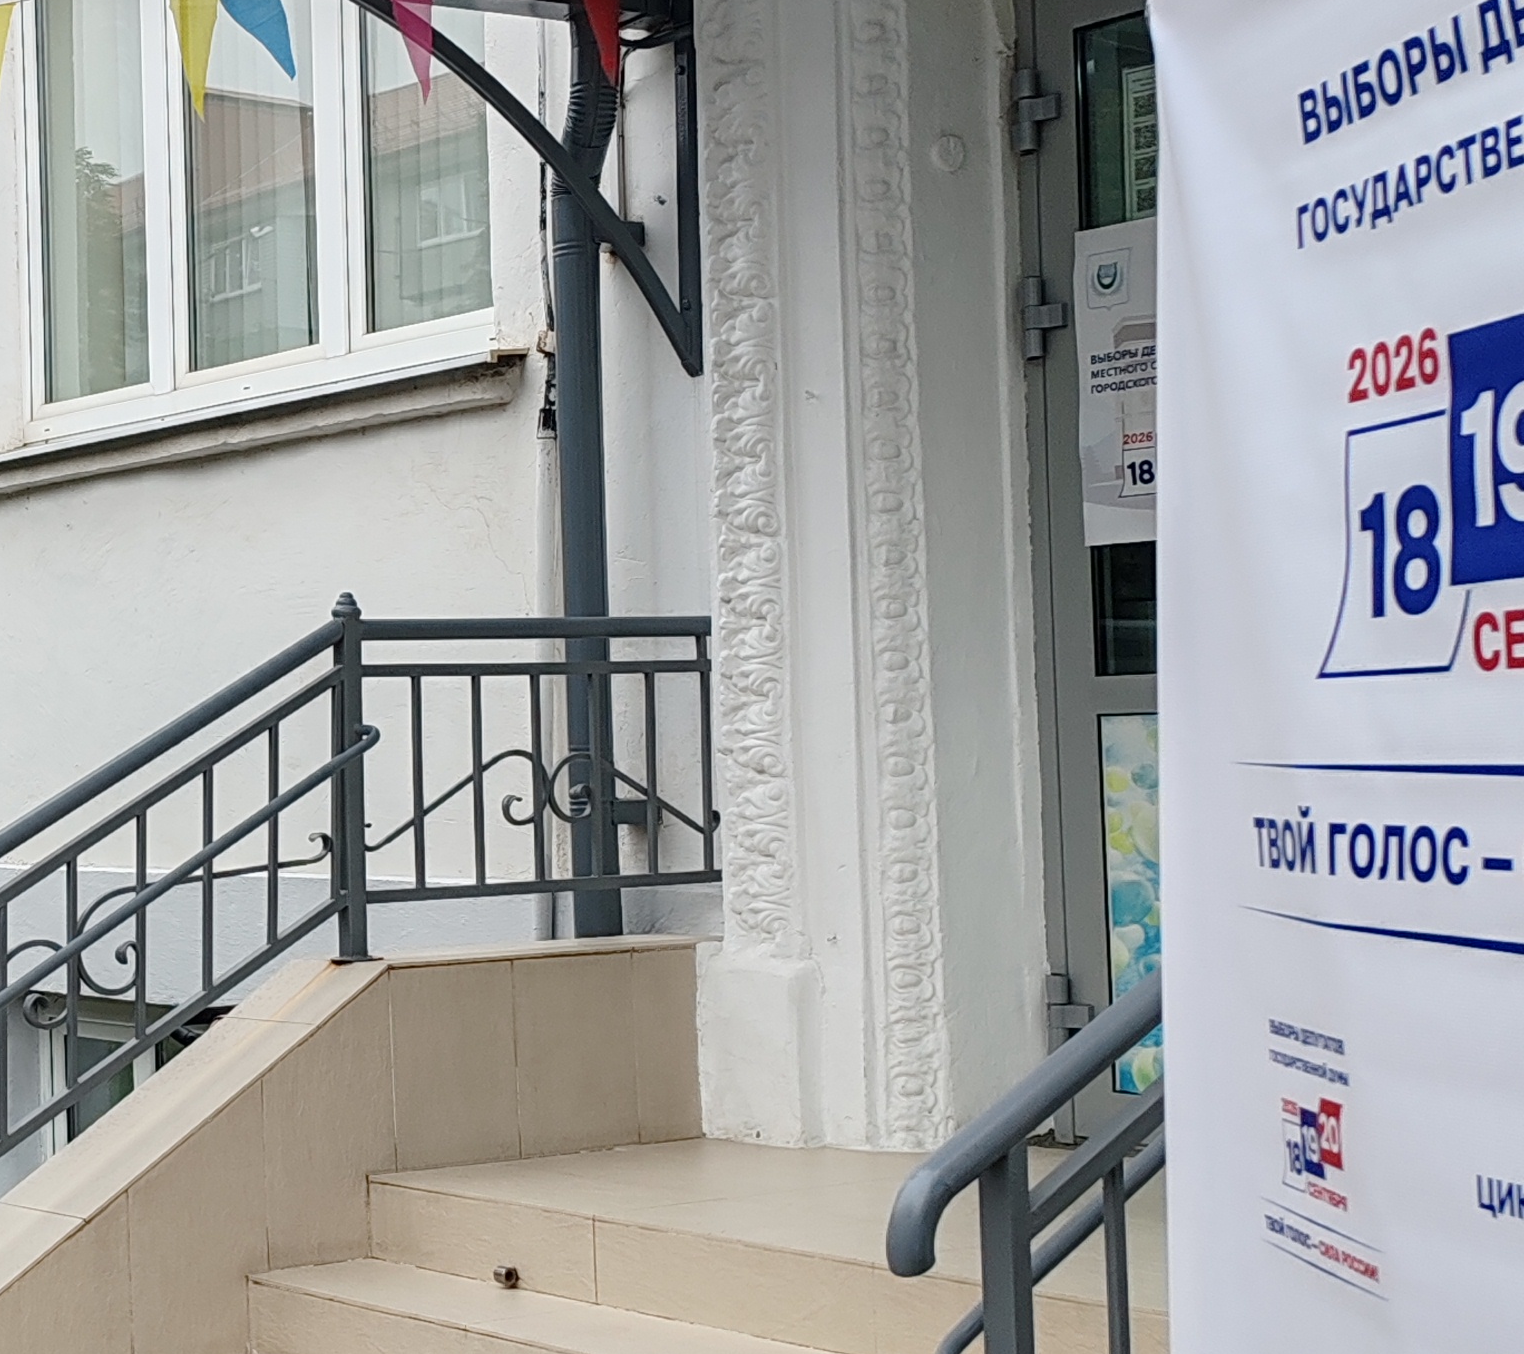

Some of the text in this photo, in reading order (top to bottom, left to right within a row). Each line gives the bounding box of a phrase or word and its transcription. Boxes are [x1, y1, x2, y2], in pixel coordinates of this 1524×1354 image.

[1298, 14, 1468, 145] ВЫБОРЫ
[1296, 114, 1524, 250] ГОСУДАРСТВЕ
[1090, 347, 1139, 365] ВЫБОРЫ
[1090, 361, 1148, 380] МЕСТНОГО
[1347, 327, 1440, 403] 2026
[1123, 431, 1153, 446] 2026
[1127, 459, 1155, 486] 18
[1359, 484, 1442, 618] 18
[1473, 608, 1524, 671] СЕ
[1253, 805, 1317, 874] ТВОЙ
[1329, 822, 1469, 885] ГОЛОС
[1302, 1124, 1320, 1164] 19
[1319, 1112, 1340, 1154] 20
